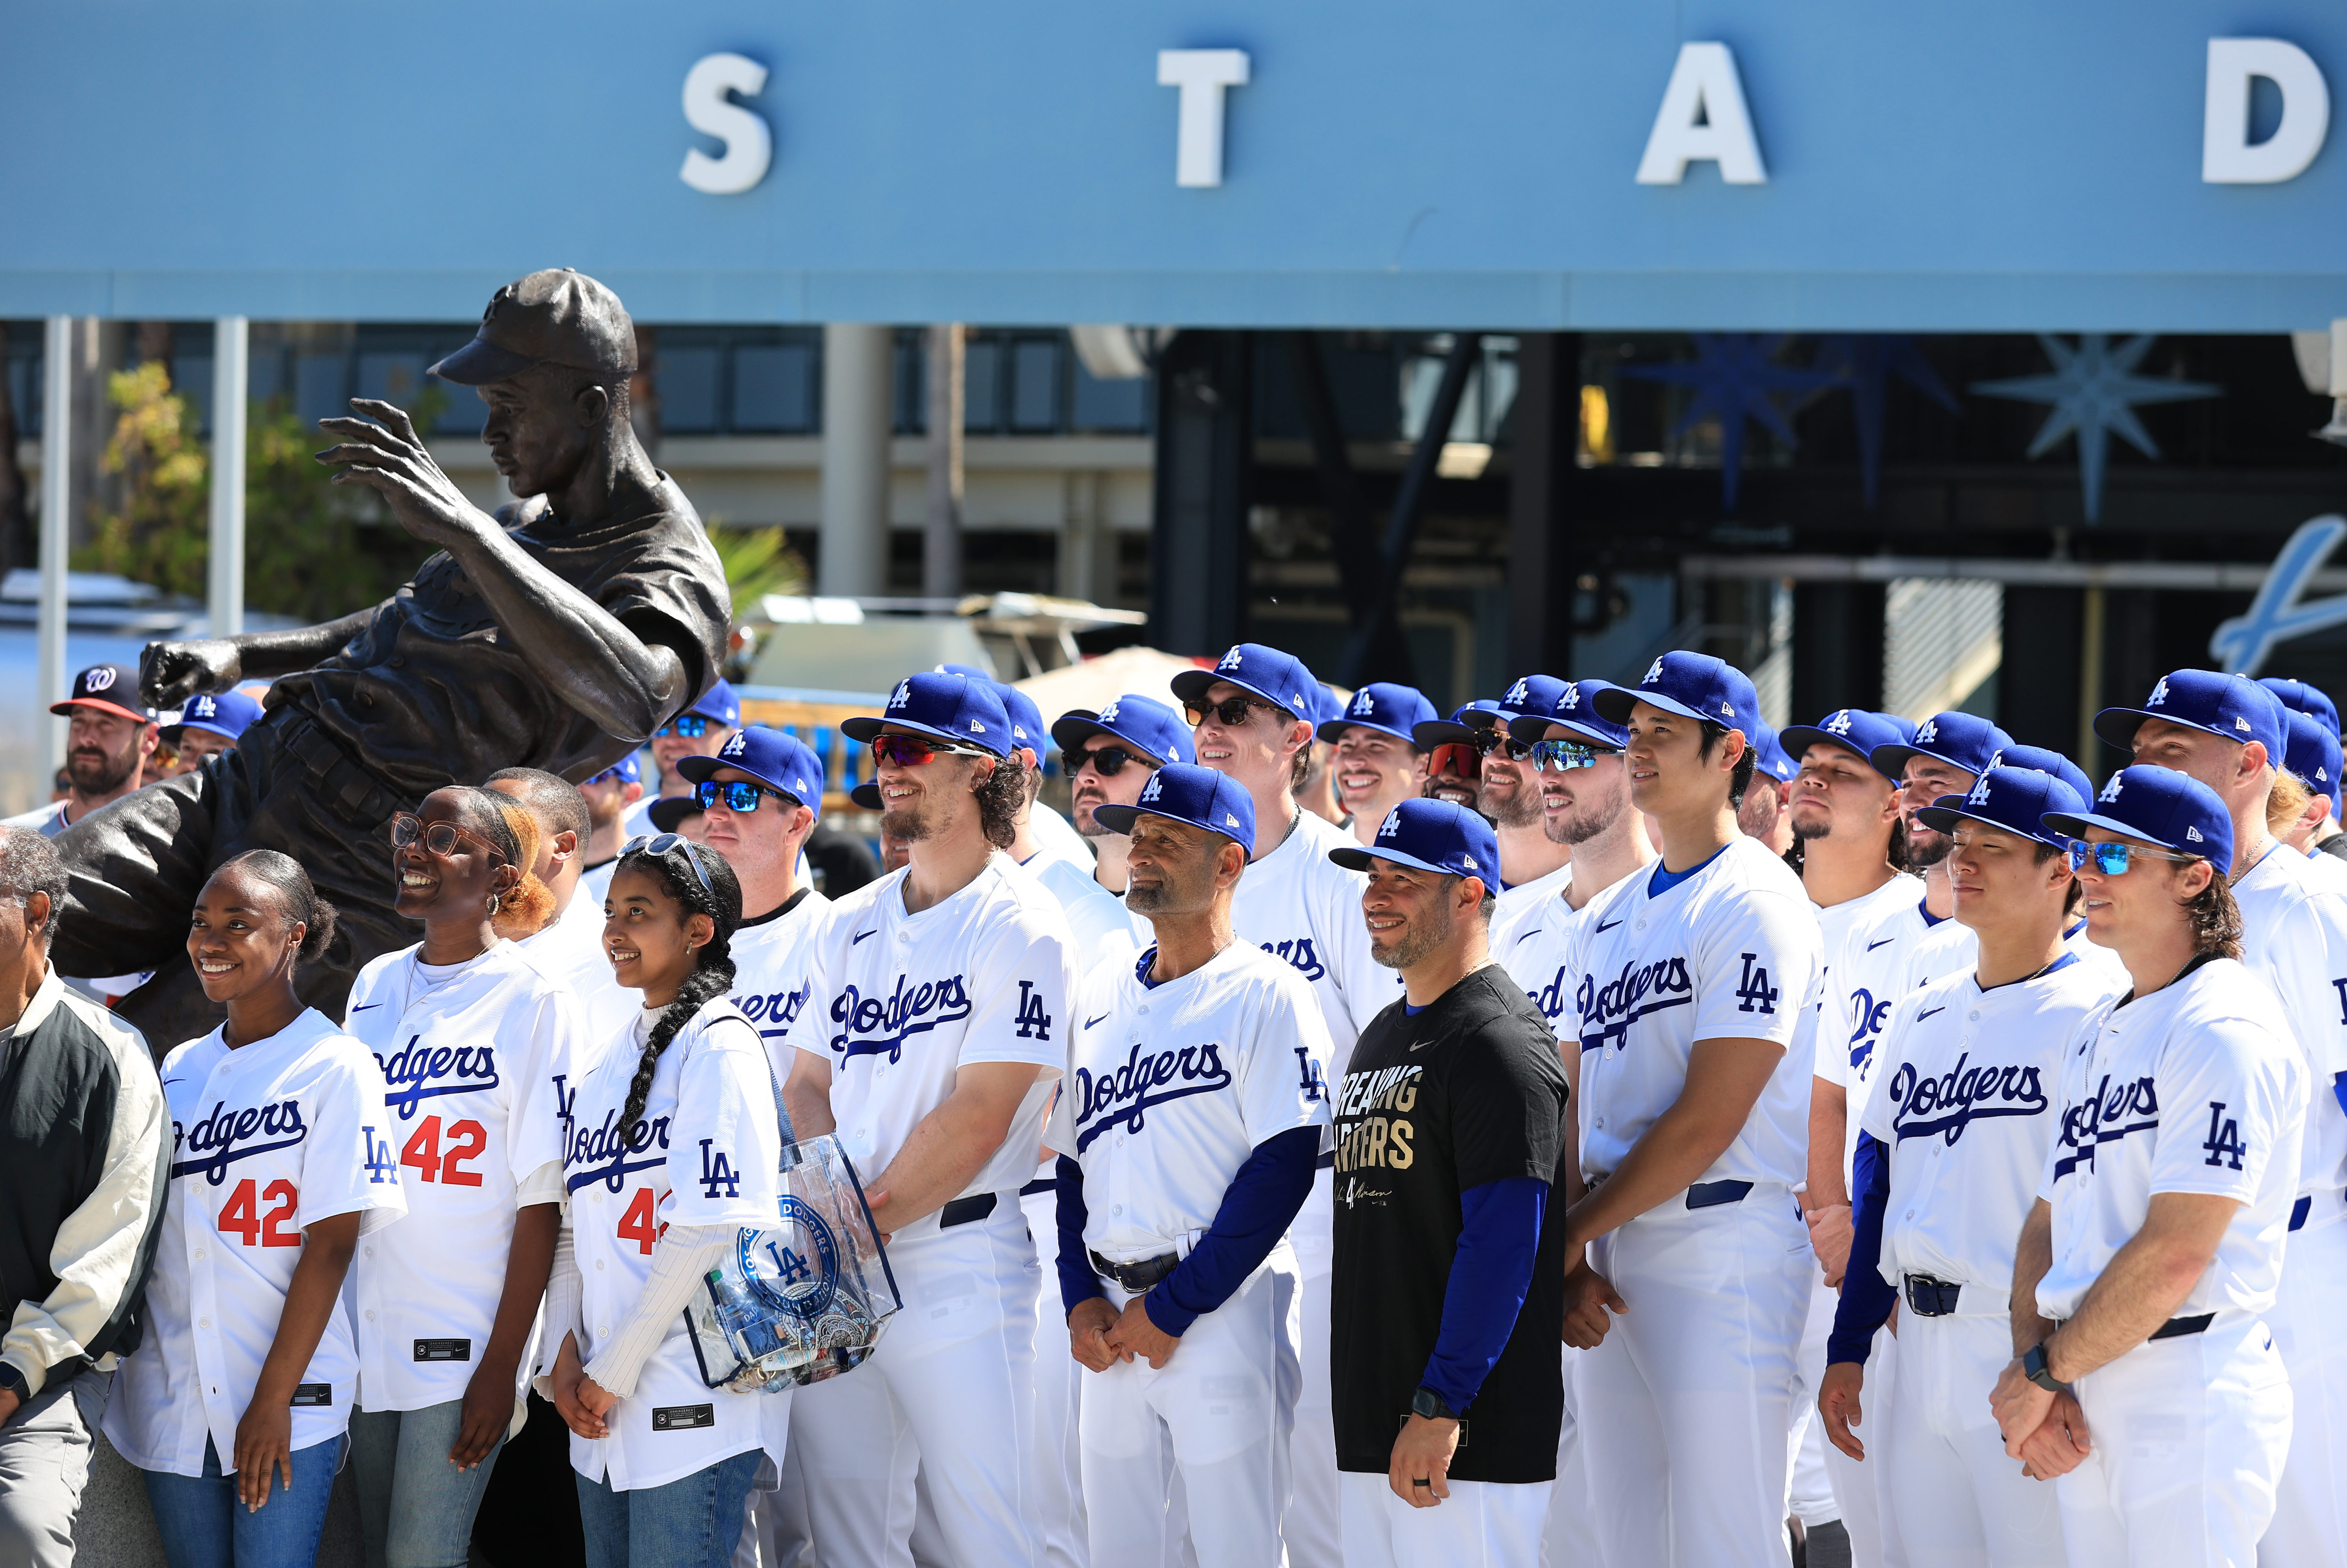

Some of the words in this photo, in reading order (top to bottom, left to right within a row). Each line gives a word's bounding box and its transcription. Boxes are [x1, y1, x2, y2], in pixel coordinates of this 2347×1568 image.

[1219, 645, 1243, 670] LA
[1642, 655, 1663, 685] LA
[890, 678, 911, 709] LA
[1353, 687, 1374, 715] LA
[1507, 677, 1528, 706] LA
[1557, 682, 1580, 710] LA
[2147, 675, 2169, 707] LA
[1097, 695, 1119, 723] LA
[1826, 709, 1852, 736] LA
[723, 729, 746, 757] LA
[1916, 715, 1938, 744] LA
[1142, 770, 1163, 802] LA
[1969, 772, 1991, 806] LA
[2098, 769, 2124, 803] LA
[1379, 804, 1401, 837] LA
[1735, 953, 1778, 1014] LA
[831, 974, 971, 1074] Dodgers
[1014, 980, 1051, 1041] LA
[1076, 1043, 1232, 1160] Dodgers
[1890, 1052, 2048, 1151] Dodgers
[400, 1115, 487, 1187] 42
[564, 1108, 671, 1196] Dodger
[2203, 1101, 2246, 1170] LA
[361, 1126, 398, 1185] LA
[699, 1138, 740, 1198] LA
[218, 1179, 301, 1247] 42
[617, 1187, 672, 1255] 4
[783, 1203, 830, 1254] DODGERS
[765, 1240, 812, 1286] LA
